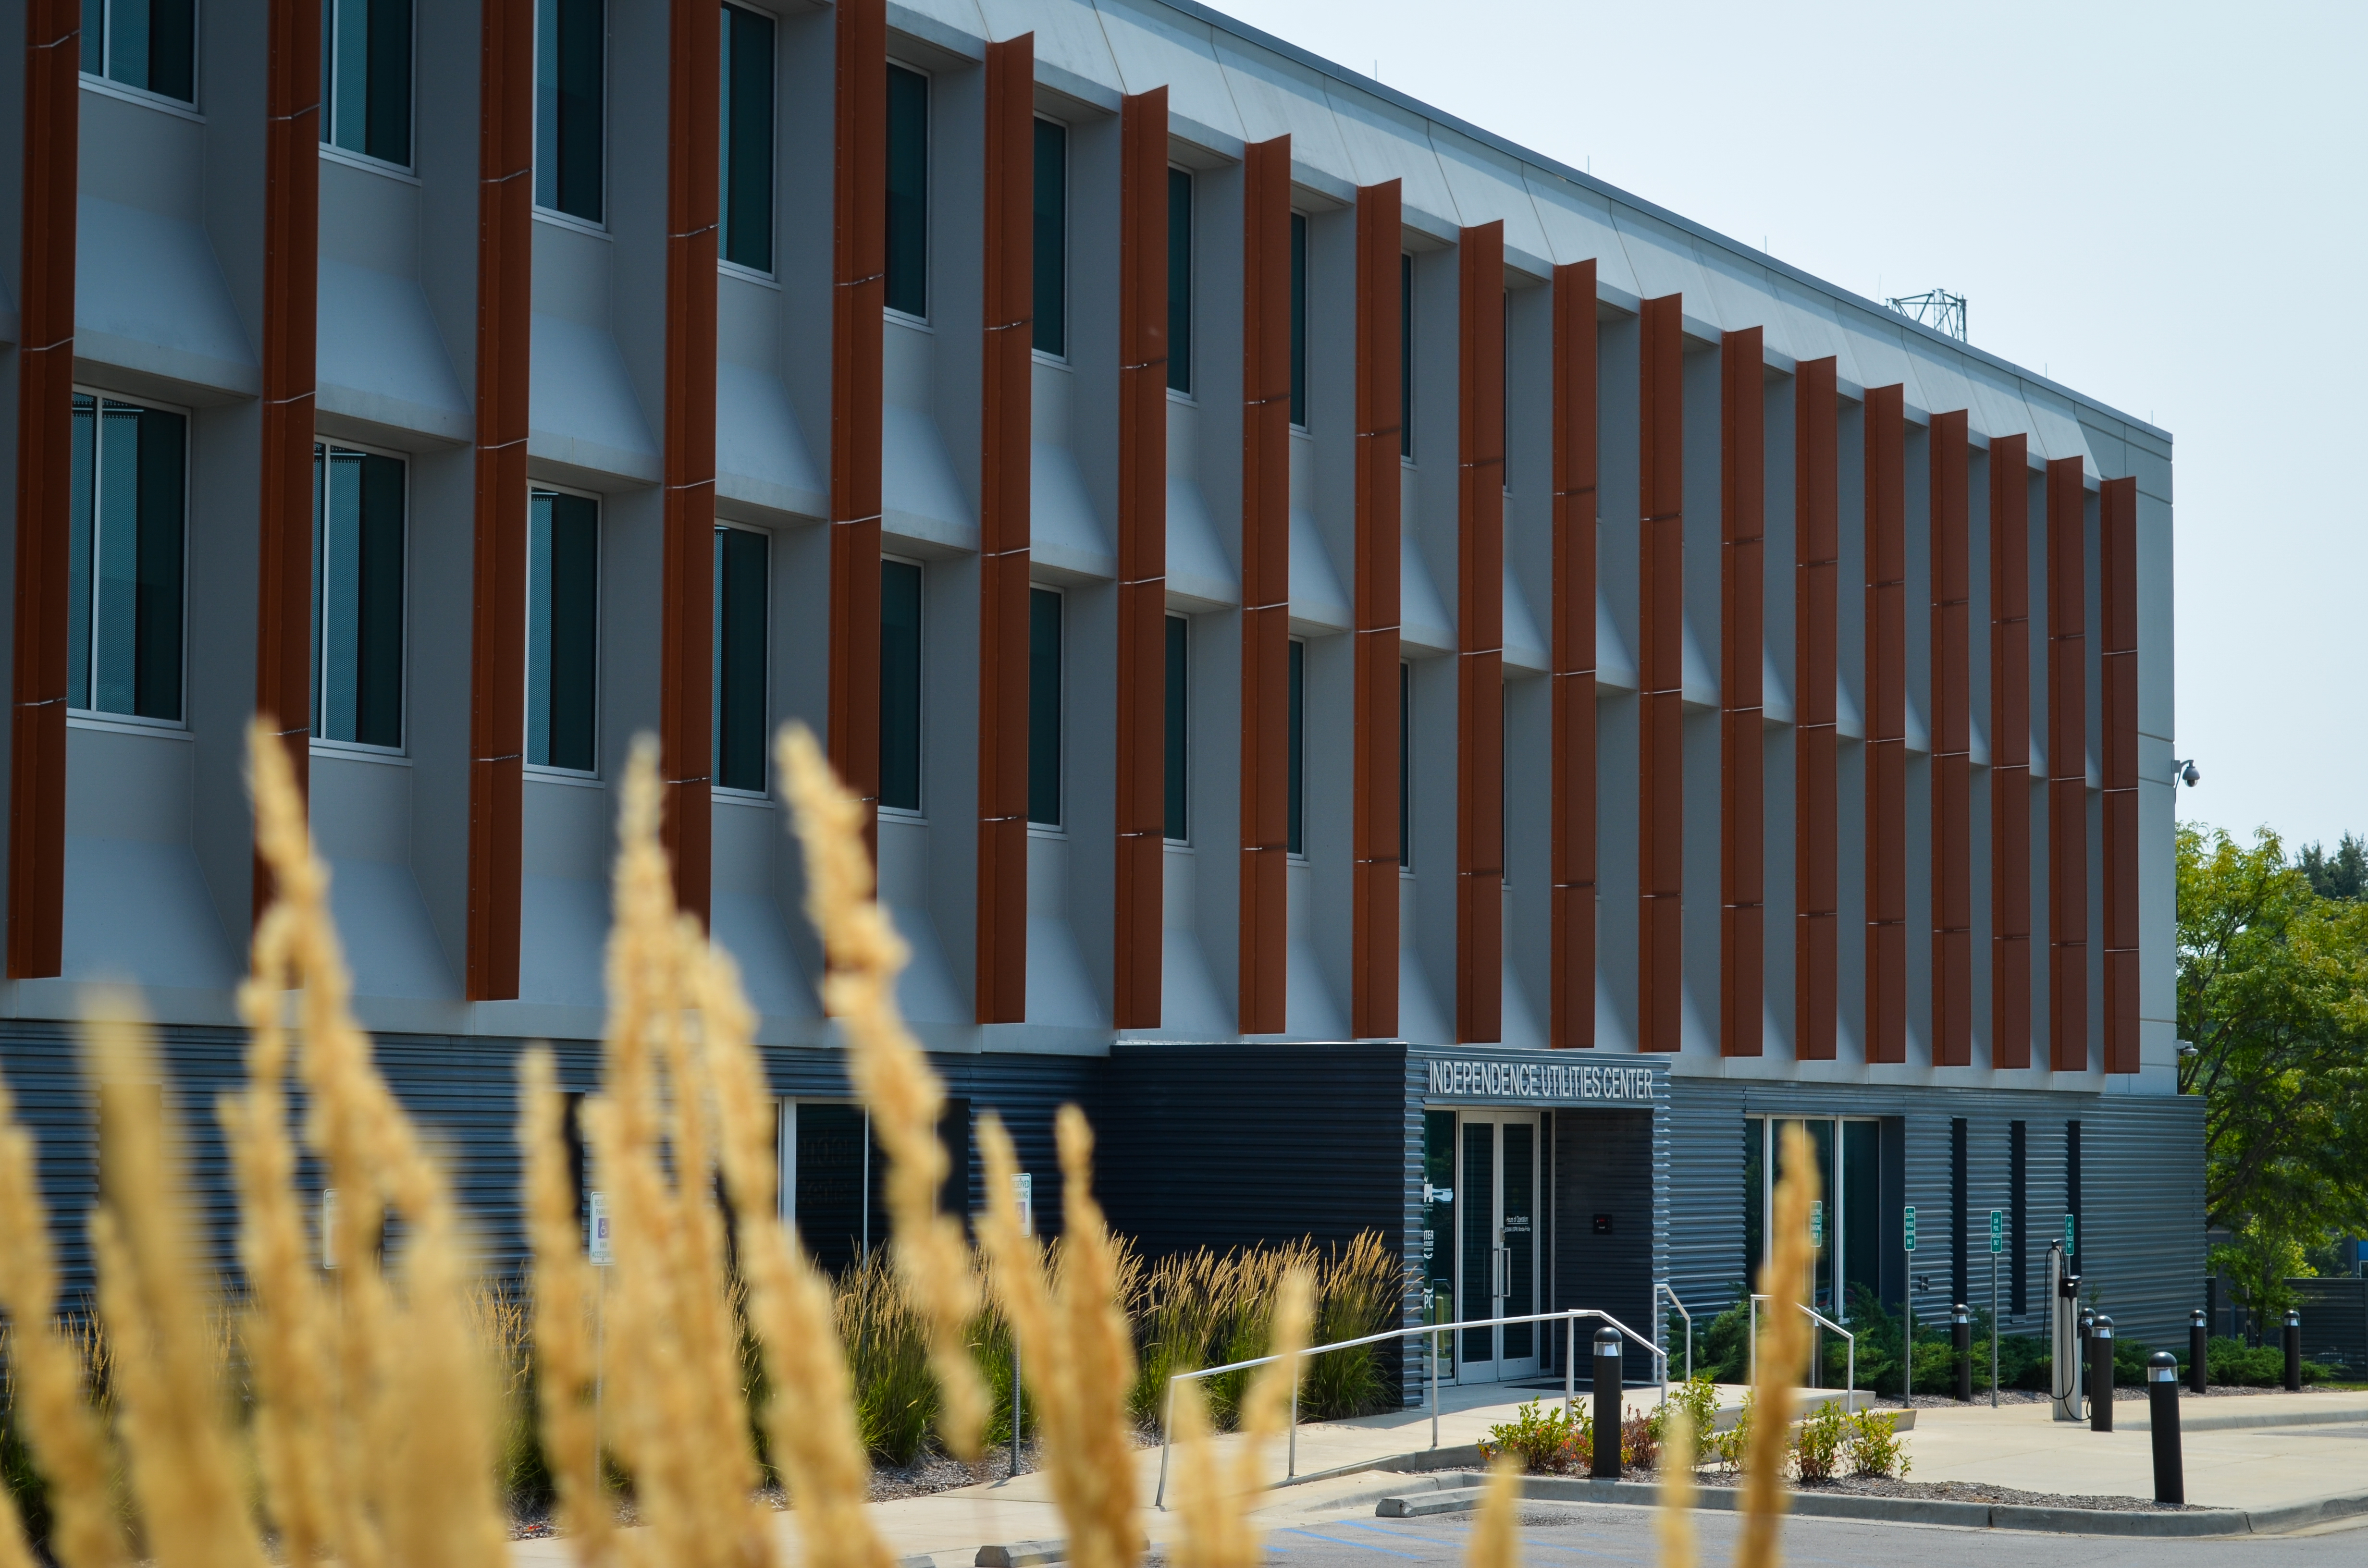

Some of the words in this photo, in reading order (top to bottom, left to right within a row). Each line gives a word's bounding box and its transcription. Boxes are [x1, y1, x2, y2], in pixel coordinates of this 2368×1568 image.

[1430, 1061, 1538, 1096] INDEPENDENCE
[1541, 1066, 1600, 1098] UTILITIES
[1603, 1067, 1653, 1099] CENTER
